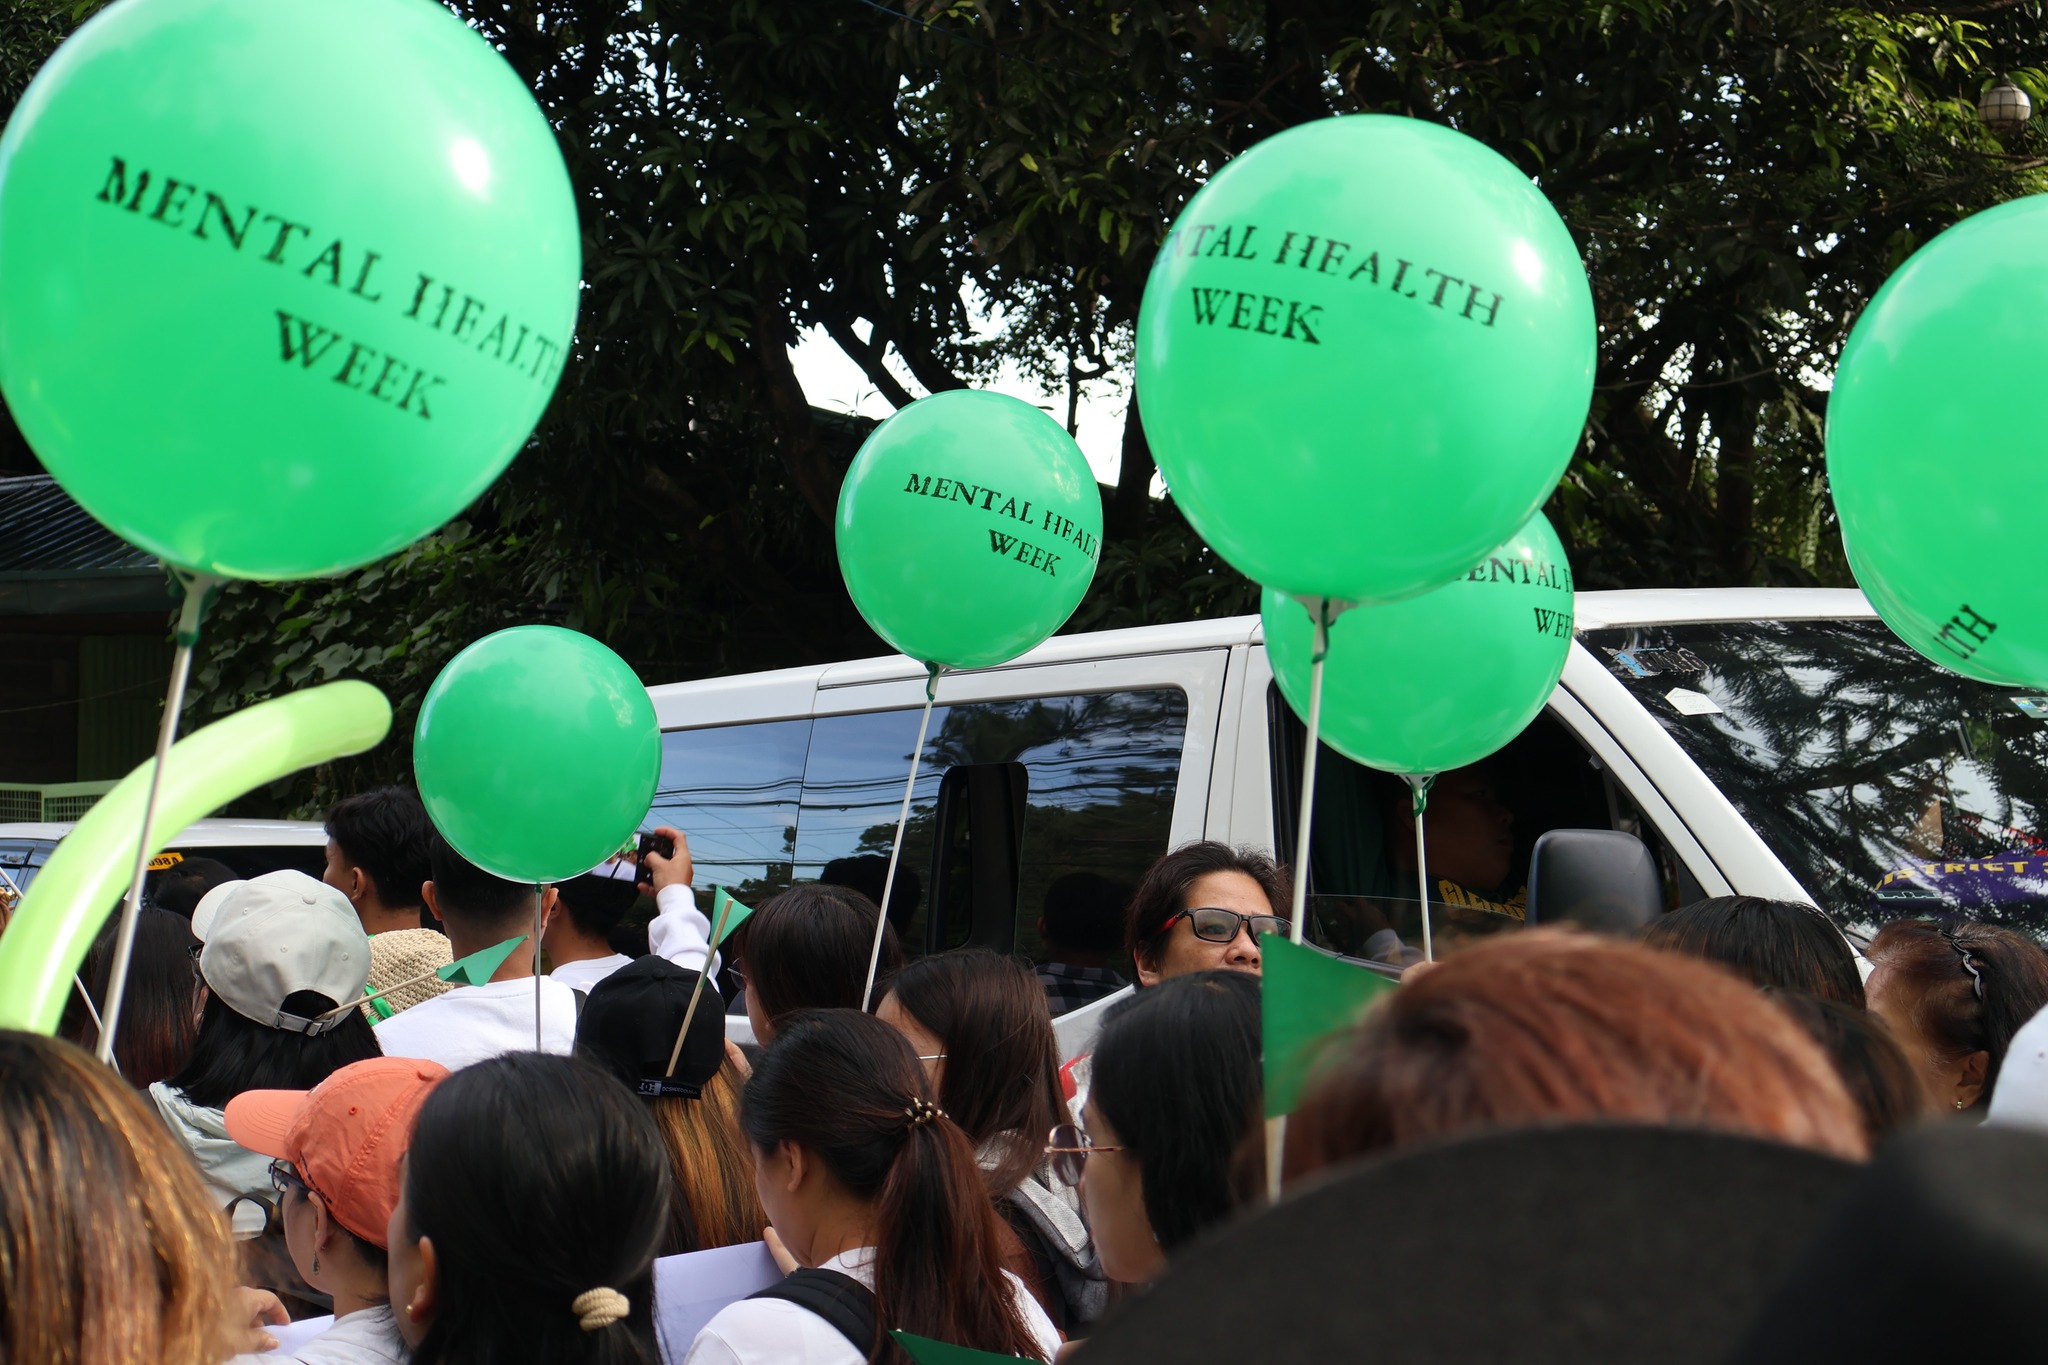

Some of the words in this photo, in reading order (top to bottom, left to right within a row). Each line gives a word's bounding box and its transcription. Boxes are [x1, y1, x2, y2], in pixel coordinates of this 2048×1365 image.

[97, 156, 382, 302] MENTAL
[1274, 231, 1504, 327] HEALTH
[1191, 287, 1324, 345] WEEK
[275, 309, 446, 420] WEEK
[904, 473, 1033, 524] MENTAL
[988, 529, 1061, 577] WEEK
[1453, 557, 1561, 590] ENTAL
